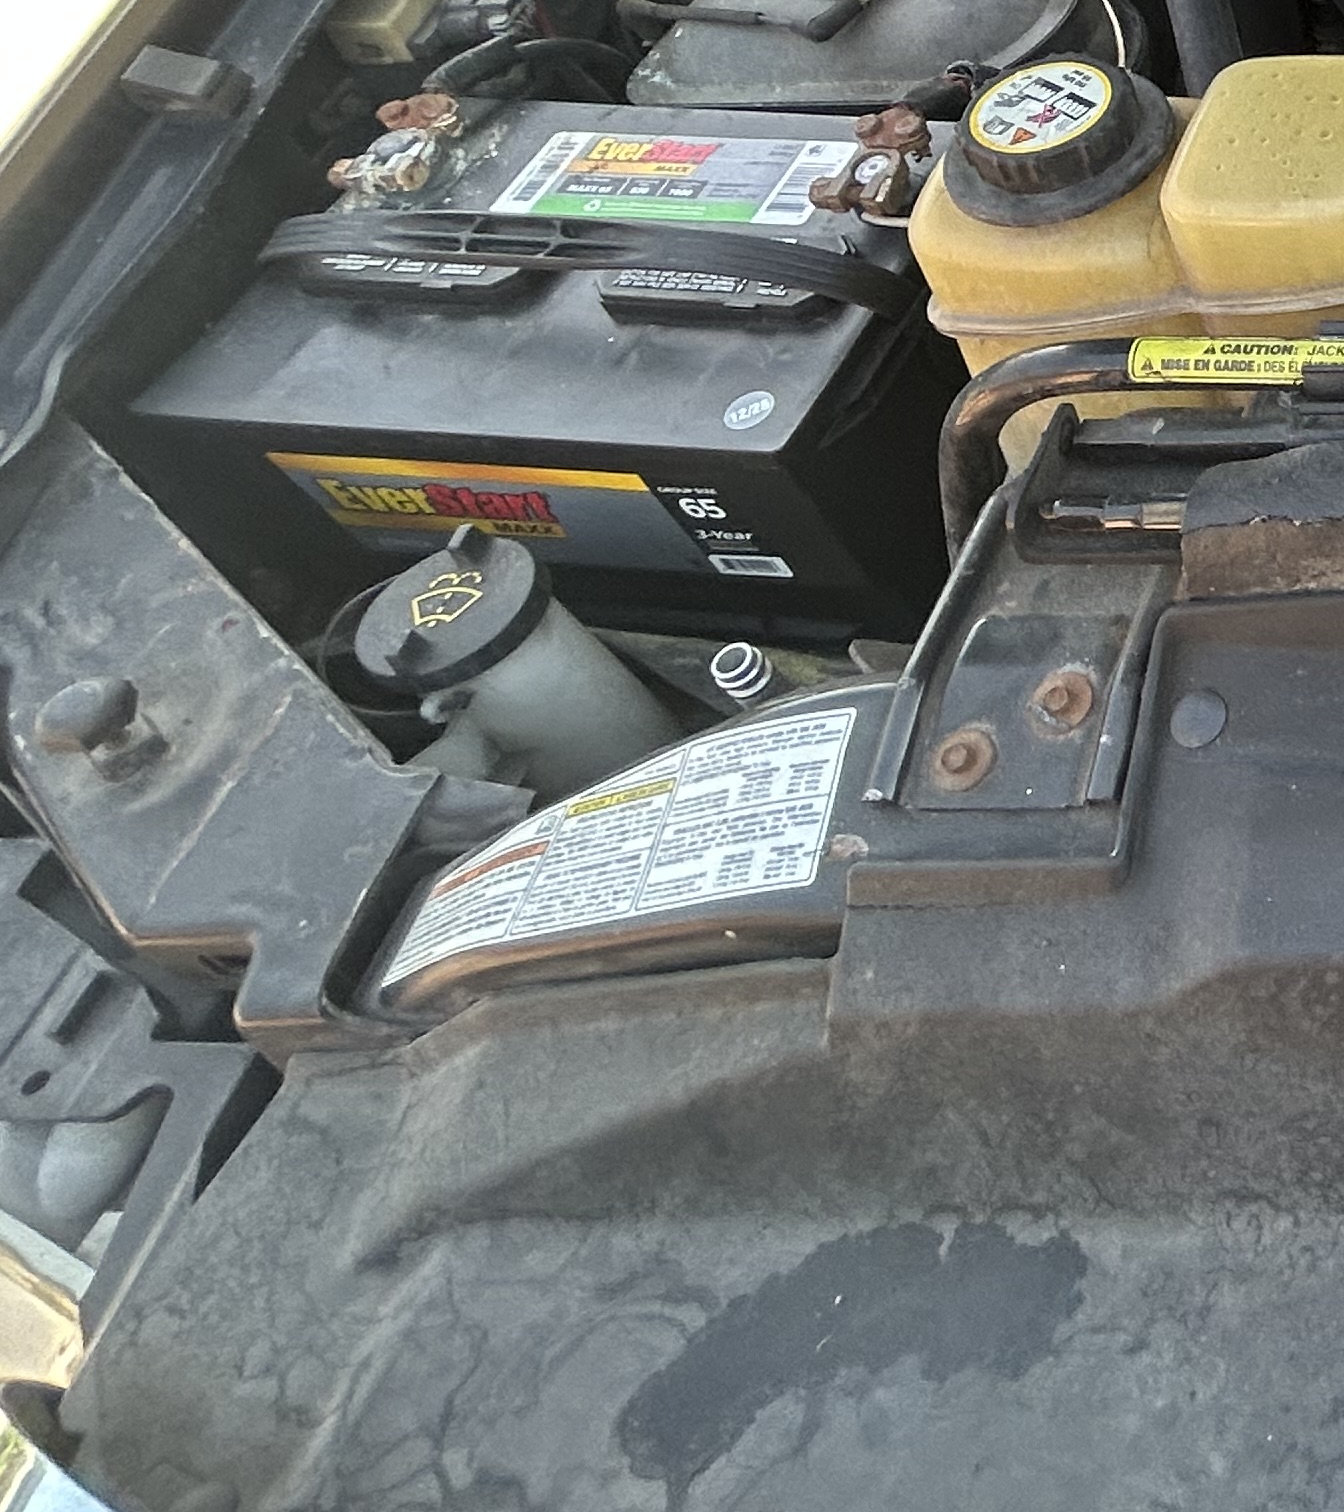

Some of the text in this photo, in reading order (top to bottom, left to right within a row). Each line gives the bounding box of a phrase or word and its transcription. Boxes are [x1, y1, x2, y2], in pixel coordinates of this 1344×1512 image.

[588, 137, 725, 164] EverStart
[1220, 343, 1298, 355] CAUTION:
[1161, 358, 1190, 371] MISE
[1194, 359, 1210, 371] EN
[1264, 360, 1286, 373] DES
[315, 476, 560, 523] EverStart
[678, 497, 727, 520] 65
[694, 529, 753, 541] 3-Year
